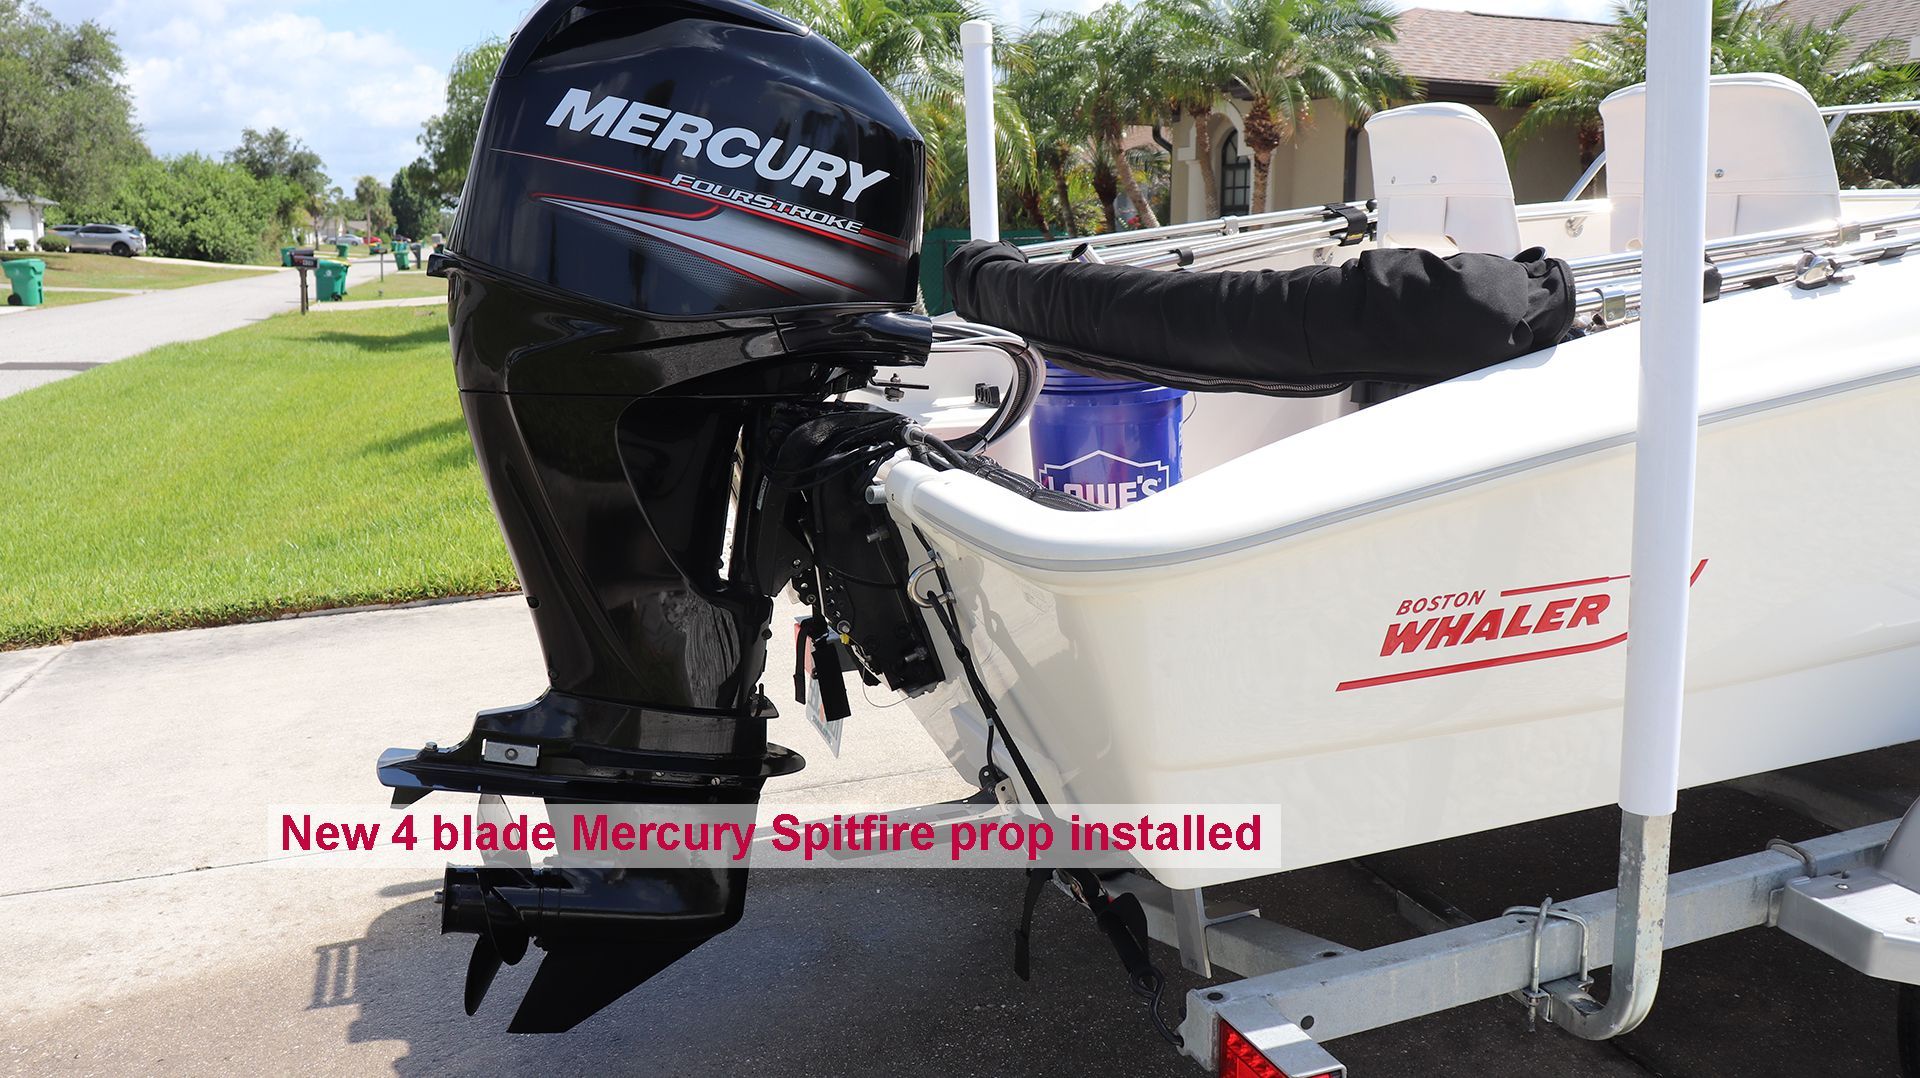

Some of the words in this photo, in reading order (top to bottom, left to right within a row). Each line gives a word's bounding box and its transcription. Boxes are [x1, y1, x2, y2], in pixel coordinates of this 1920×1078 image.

[545, 87, 891, 203] MERCURY
[670, 173, 864, 235] FOURSTROKE
[1379, 593, 1612, 658] WHALER
[1396, 589, 1487, 616] BOSTON
